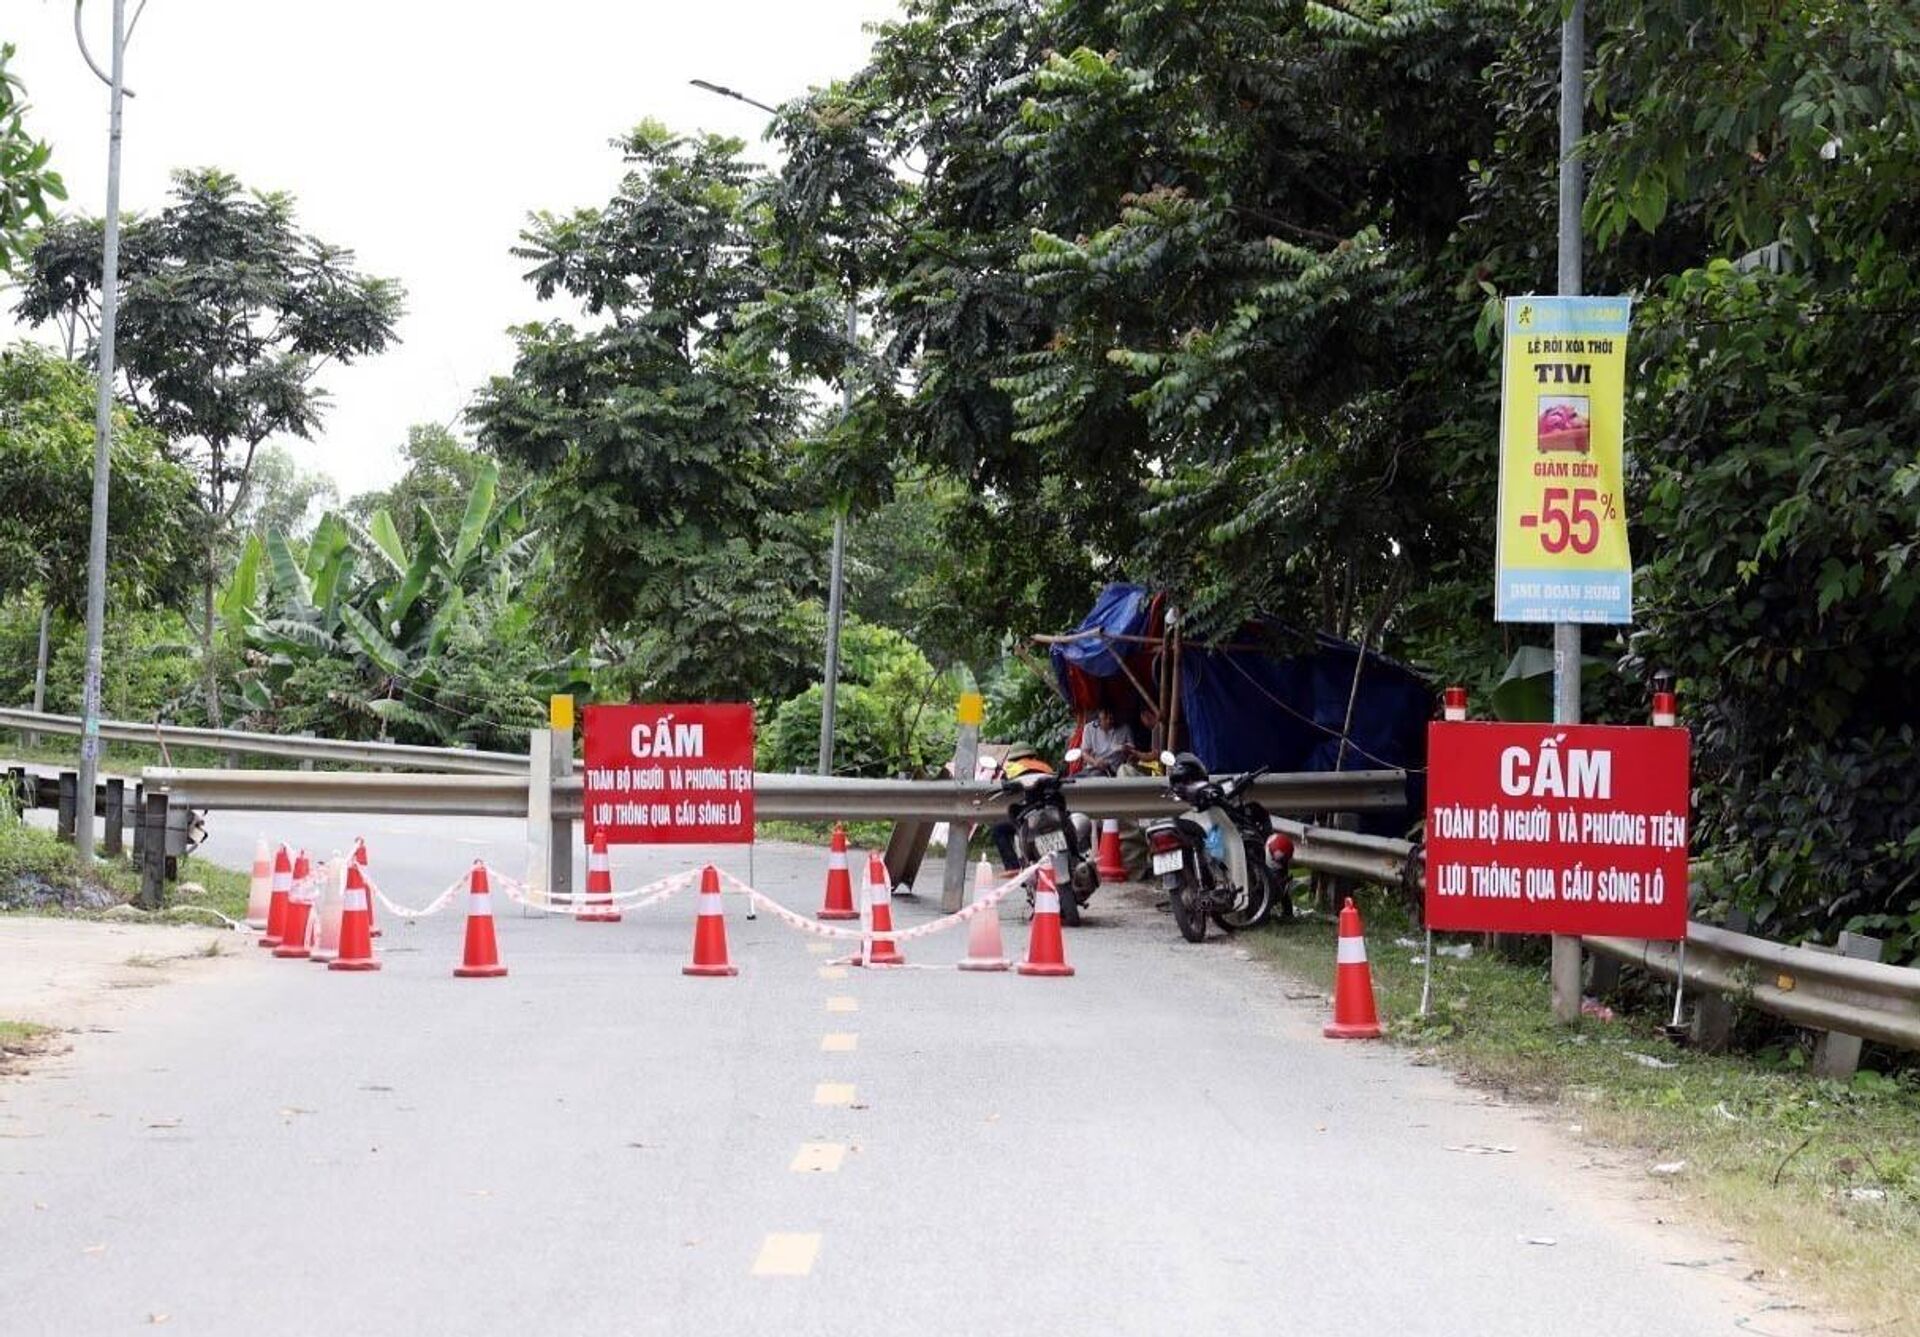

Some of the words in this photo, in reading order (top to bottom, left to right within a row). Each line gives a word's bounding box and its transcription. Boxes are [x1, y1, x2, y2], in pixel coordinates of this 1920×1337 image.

[1534, 363, 1591, 384] TIVI
[631, 713, 704, 758] CẤM
[587, 765, 614, 790] TOÀN
[617, 766, 631, 793] BỘ
[633, 764, 664, 790] NGƯỜI
[669, 765, 683, 790] VÀ
[685, 767, 727, 790] PHƯƠNG
[729, 766, 752, 793] TIỆN
[1500, 733, 1612, 799] CẤM
[616, 801, 649, 825] THÔNG
[651, 804, 671, 828] QUA
[698, 801, 726, 825] SÔNG
[728, 800, 742, 825] LÔ
[1434, 802, 1473, 839] TOÀN
[1478, 803, 1499, 846] BỘ
[1503, 804, 1550, 842] NGƯỜI
[1557, 806, 1578, 843] VÀ
[1582, 810, 1646, 846] PHƯƠNG
[1650, 810, 1686, 852] TIỆN
[1471, 861, 1521, 898] THÔNG
[1526, 868, 1555, 903] QUA
[1562, 861, 1593, 901] CẦU
[1598, 866, 1640, 904] SÔNG
[1644, 868, 1664, 905] LÔ
